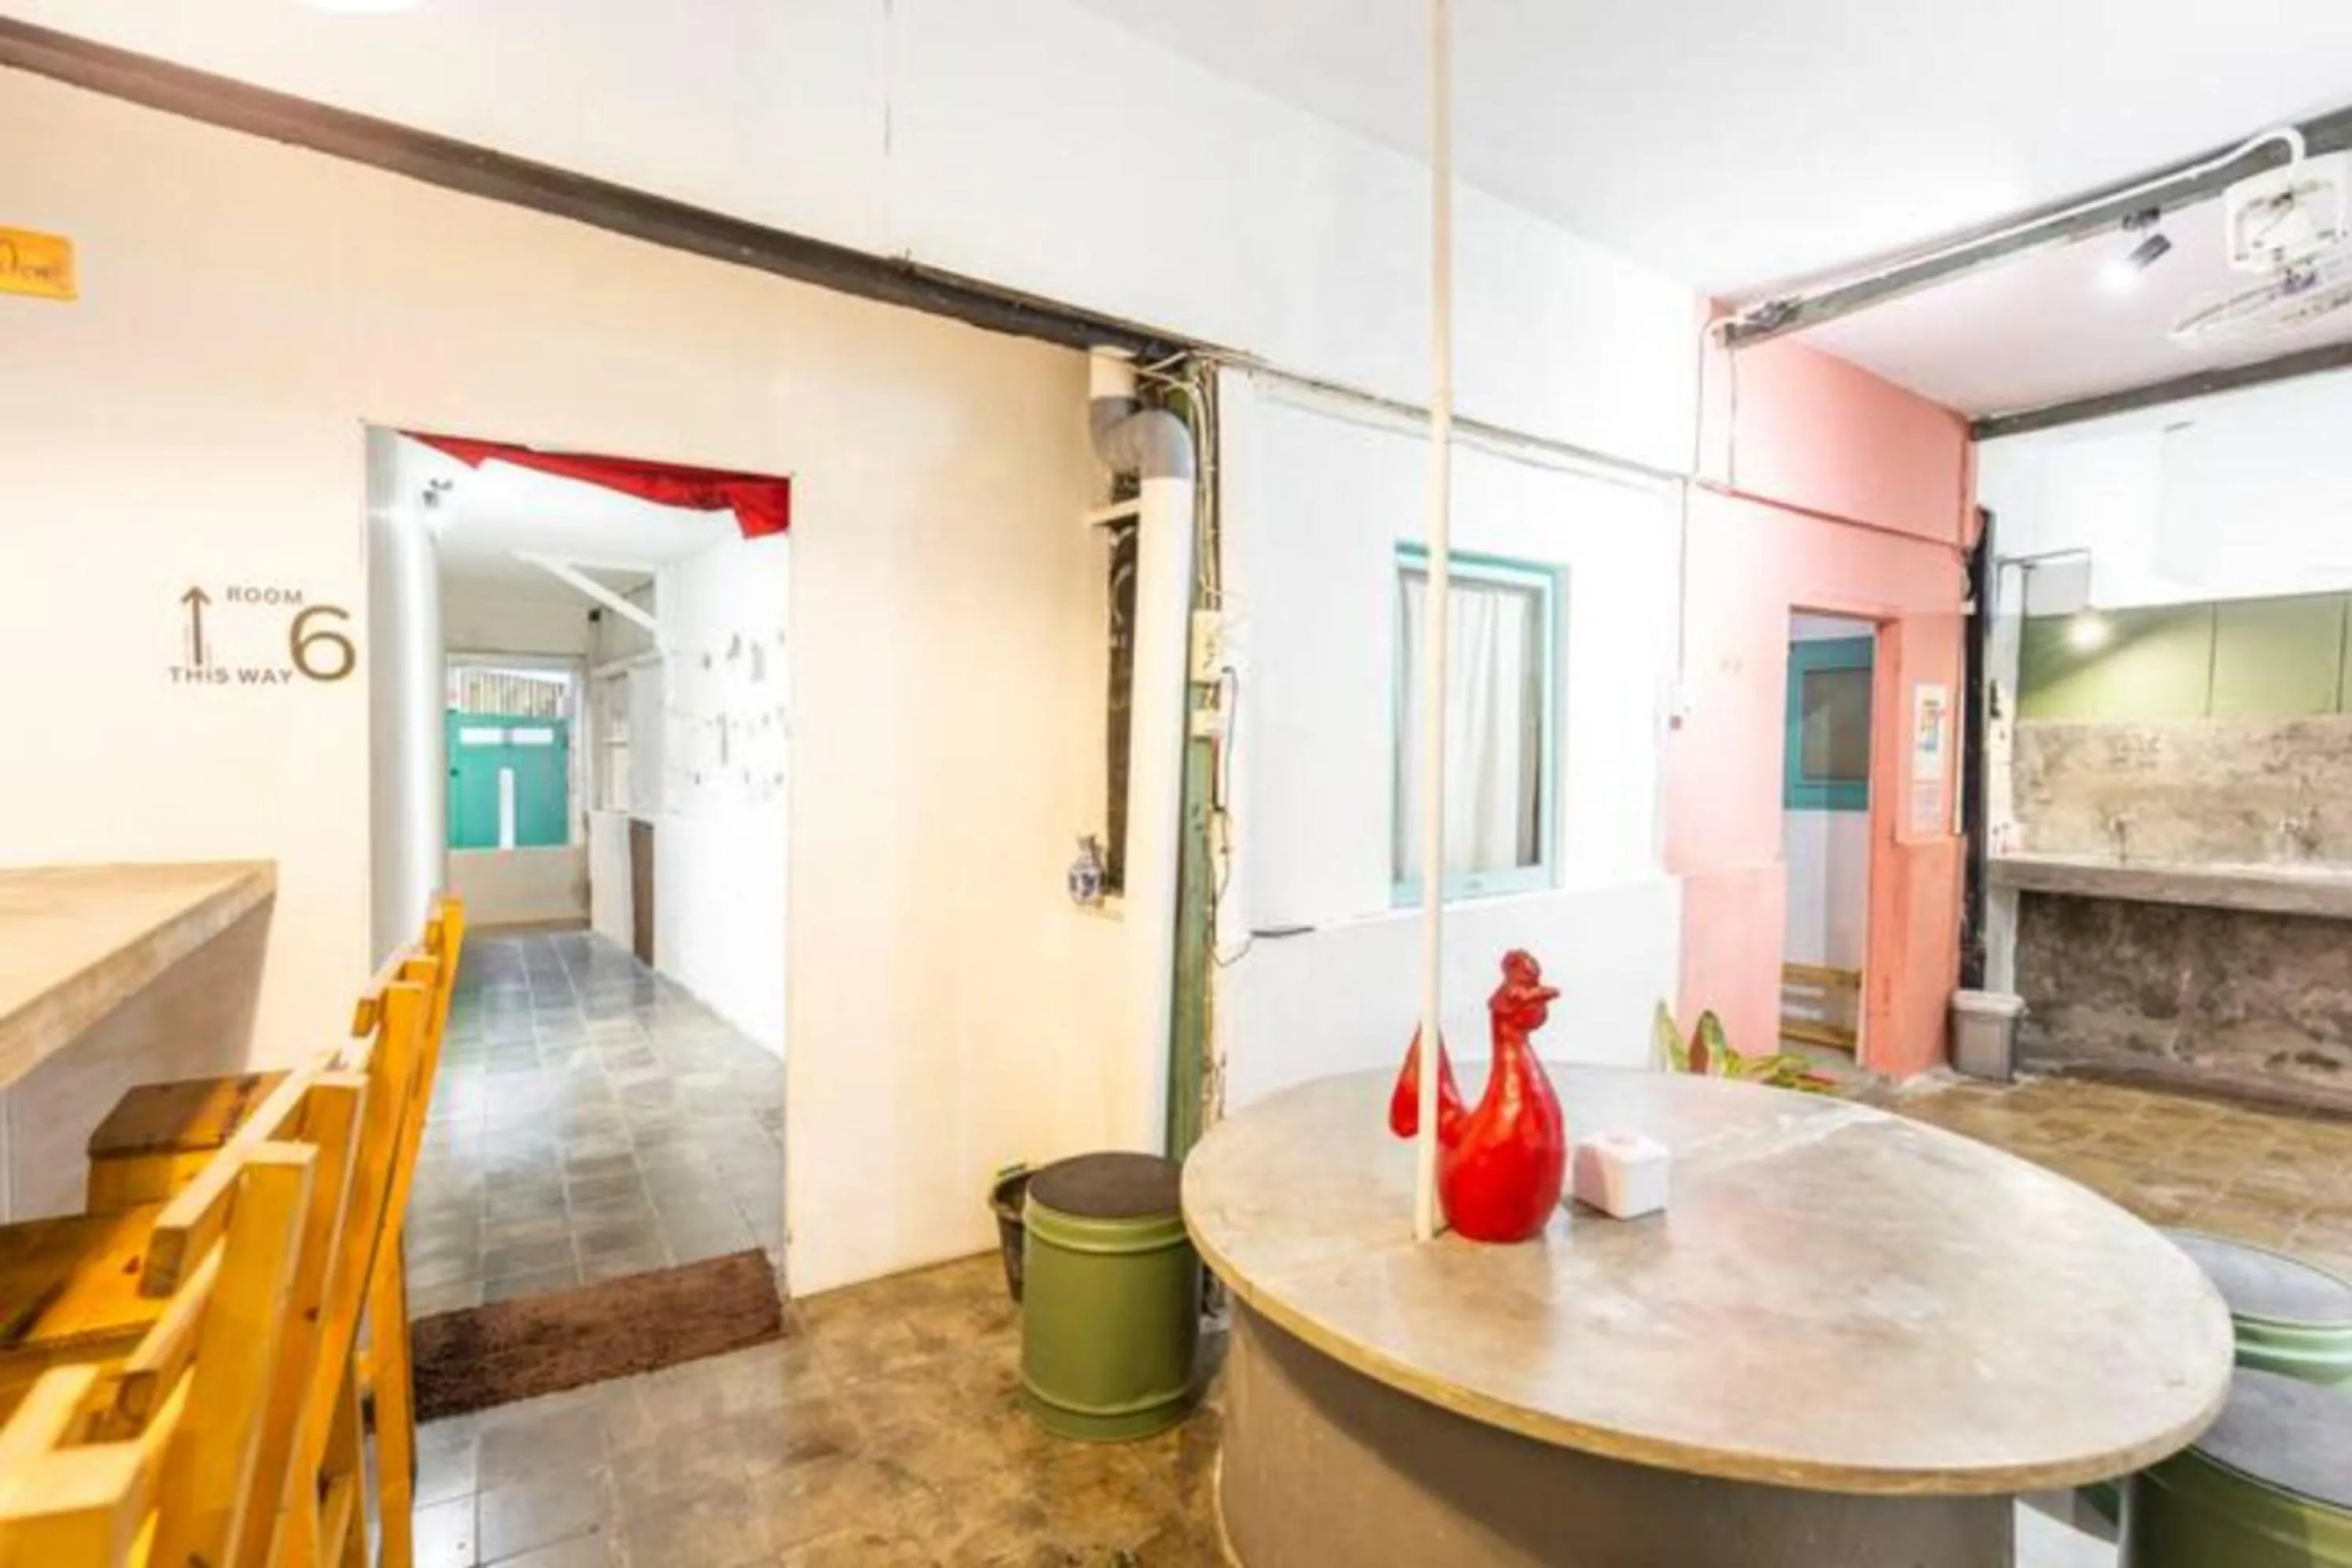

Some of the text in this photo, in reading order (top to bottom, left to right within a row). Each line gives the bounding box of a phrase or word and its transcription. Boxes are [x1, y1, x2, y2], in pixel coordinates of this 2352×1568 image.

[226, 586, 356, 681] ROOM 6
[168, 665, 293, 685] THIS WAY
